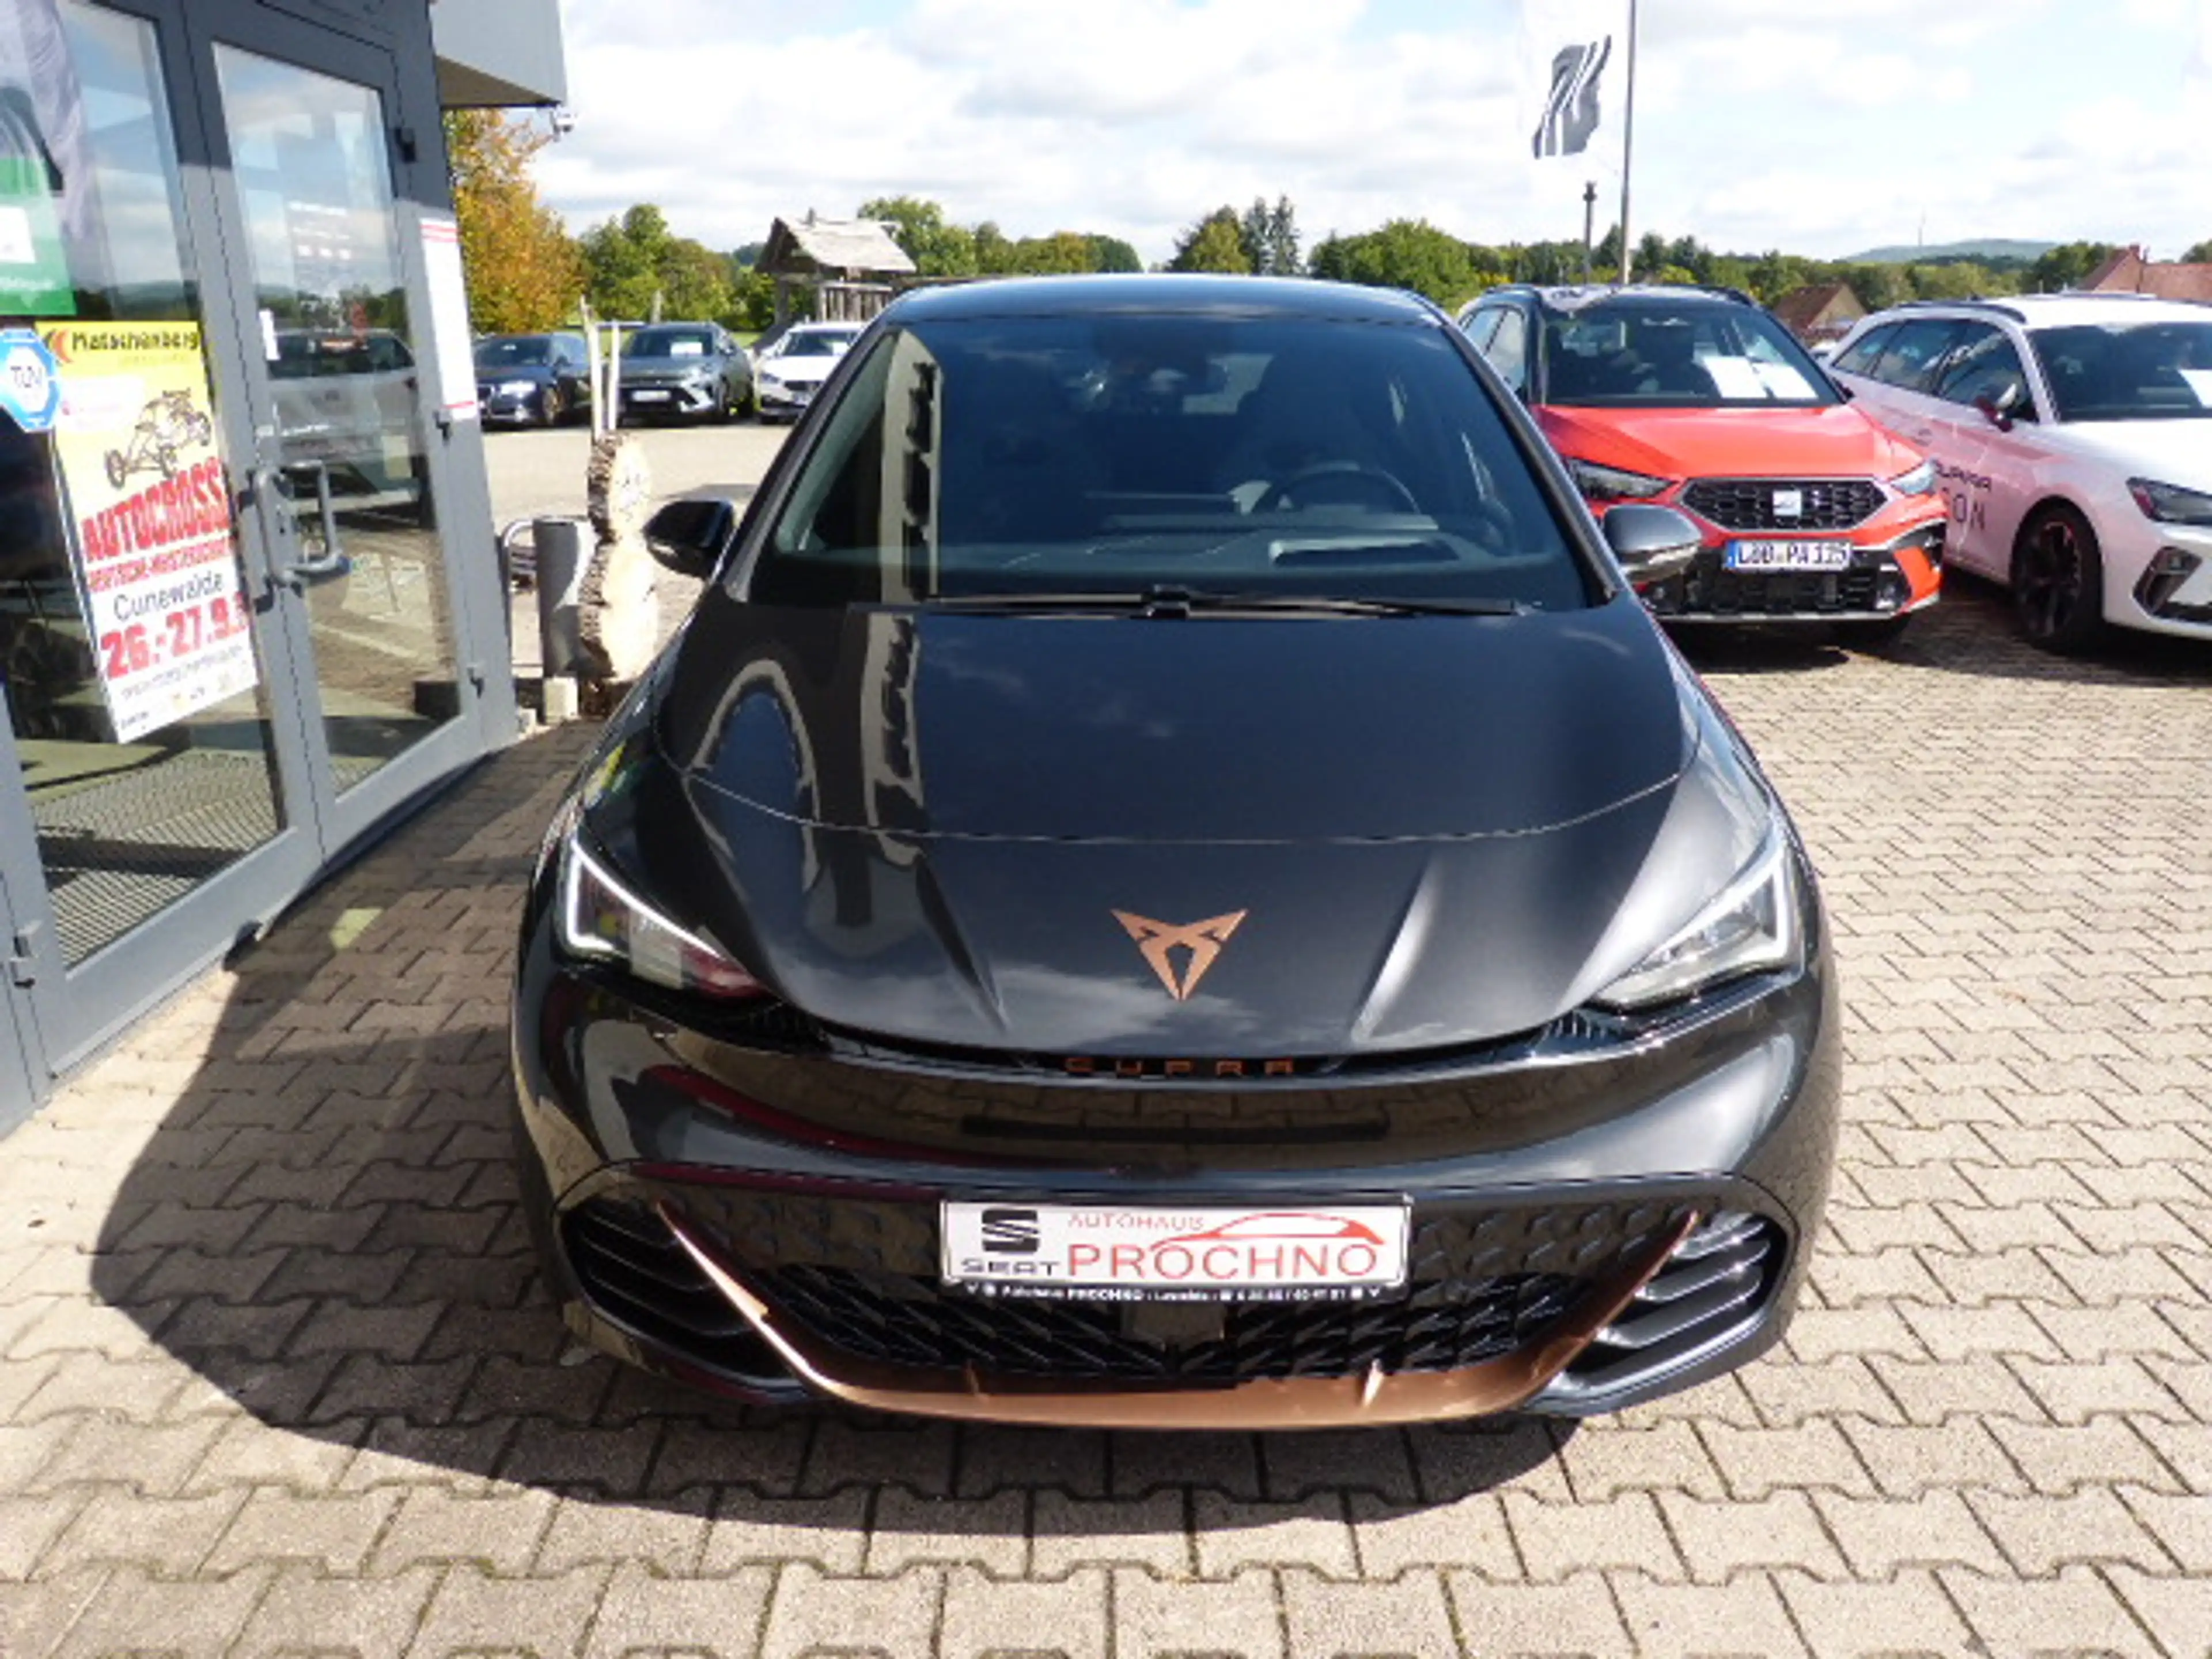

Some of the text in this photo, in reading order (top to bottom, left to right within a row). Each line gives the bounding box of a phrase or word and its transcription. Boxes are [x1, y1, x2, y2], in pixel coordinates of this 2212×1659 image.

[82, 456, 229, 563] AUTOCROSS
[114, 570, 224, 622] Cunewalde
[1065, 1058, 1294, 1076] CUPRA
[1068, 1213, 1203, 1230] AUTOHAUS
[961, 1258, 1060, 1276] SEAT
[1069, 1244, 1377, 1280] PROCHNO
